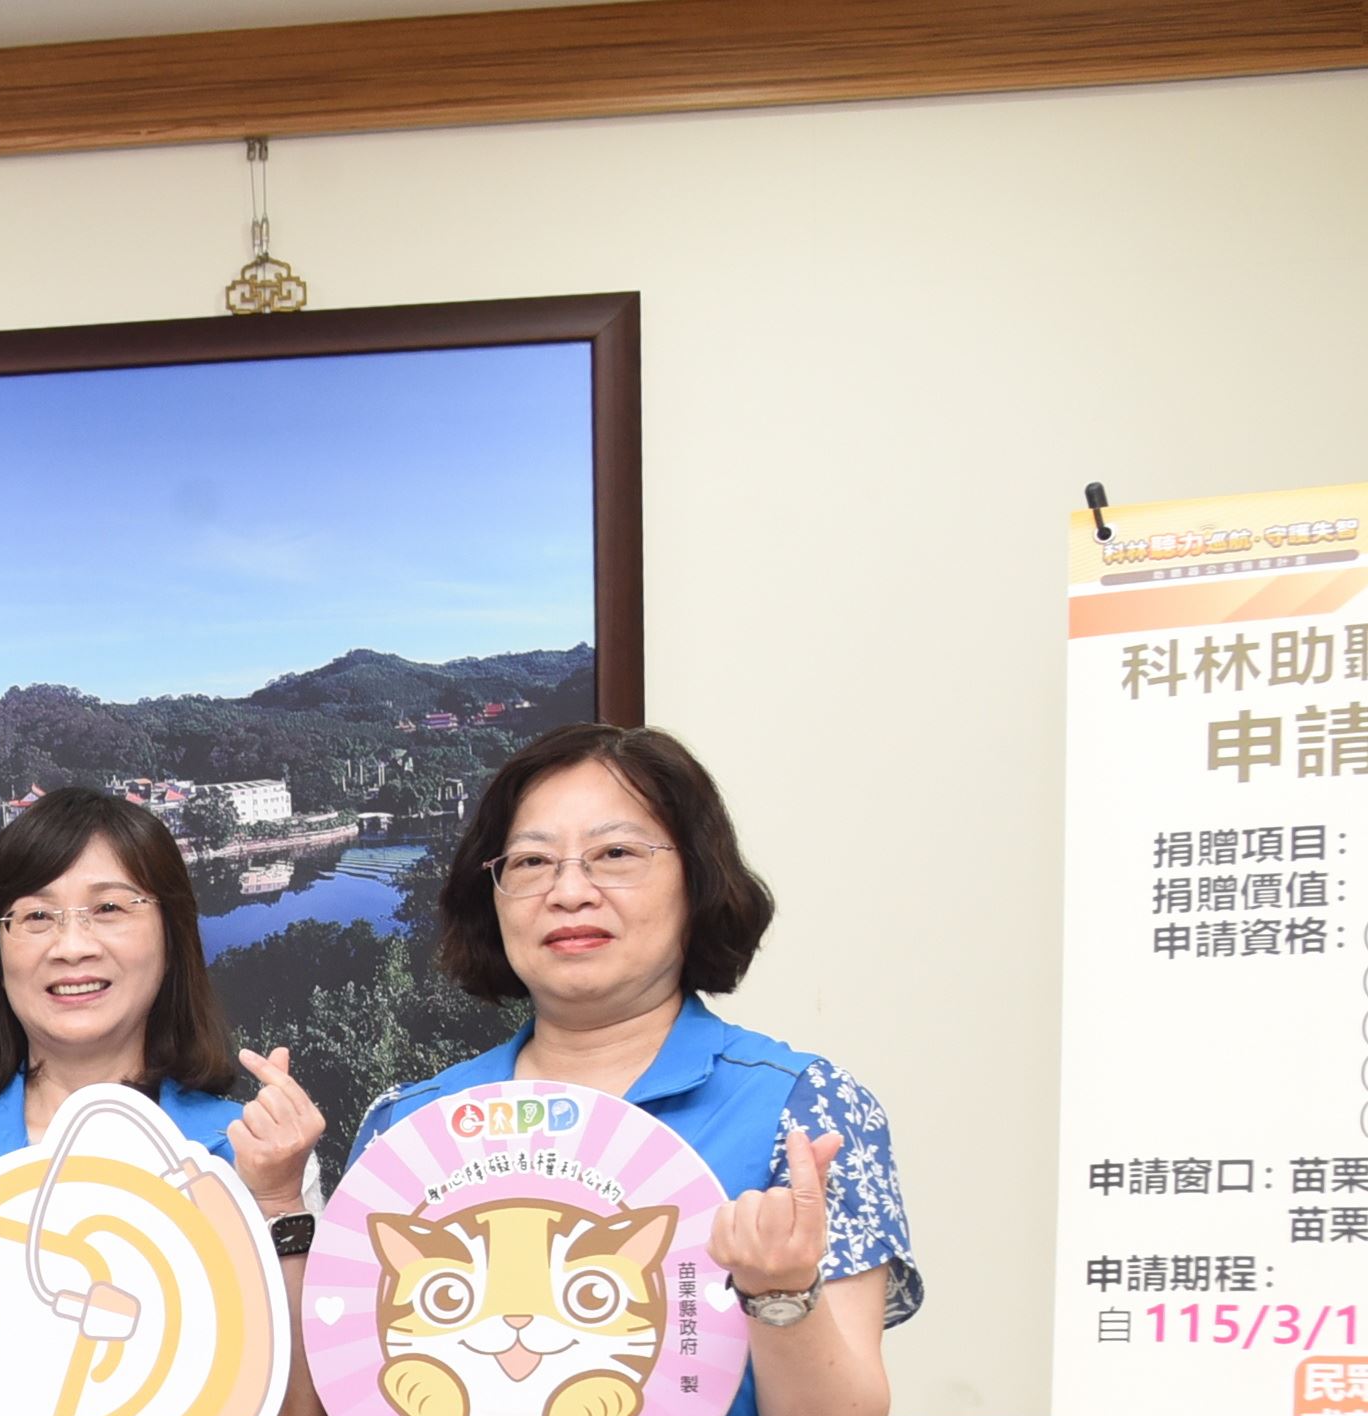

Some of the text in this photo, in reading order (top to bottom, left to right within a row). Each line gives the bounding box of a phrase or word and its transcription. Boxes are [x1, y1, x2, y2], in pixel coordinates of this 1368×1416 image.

[452, 1097, 580, 1138] CRPD
[1288, 1206, 1368, 1243] 苗栗
[677, 1261, 698, 1355] 苗栗縣政府
[1097, 1303, 1357, 1350] 自 115/3/1
